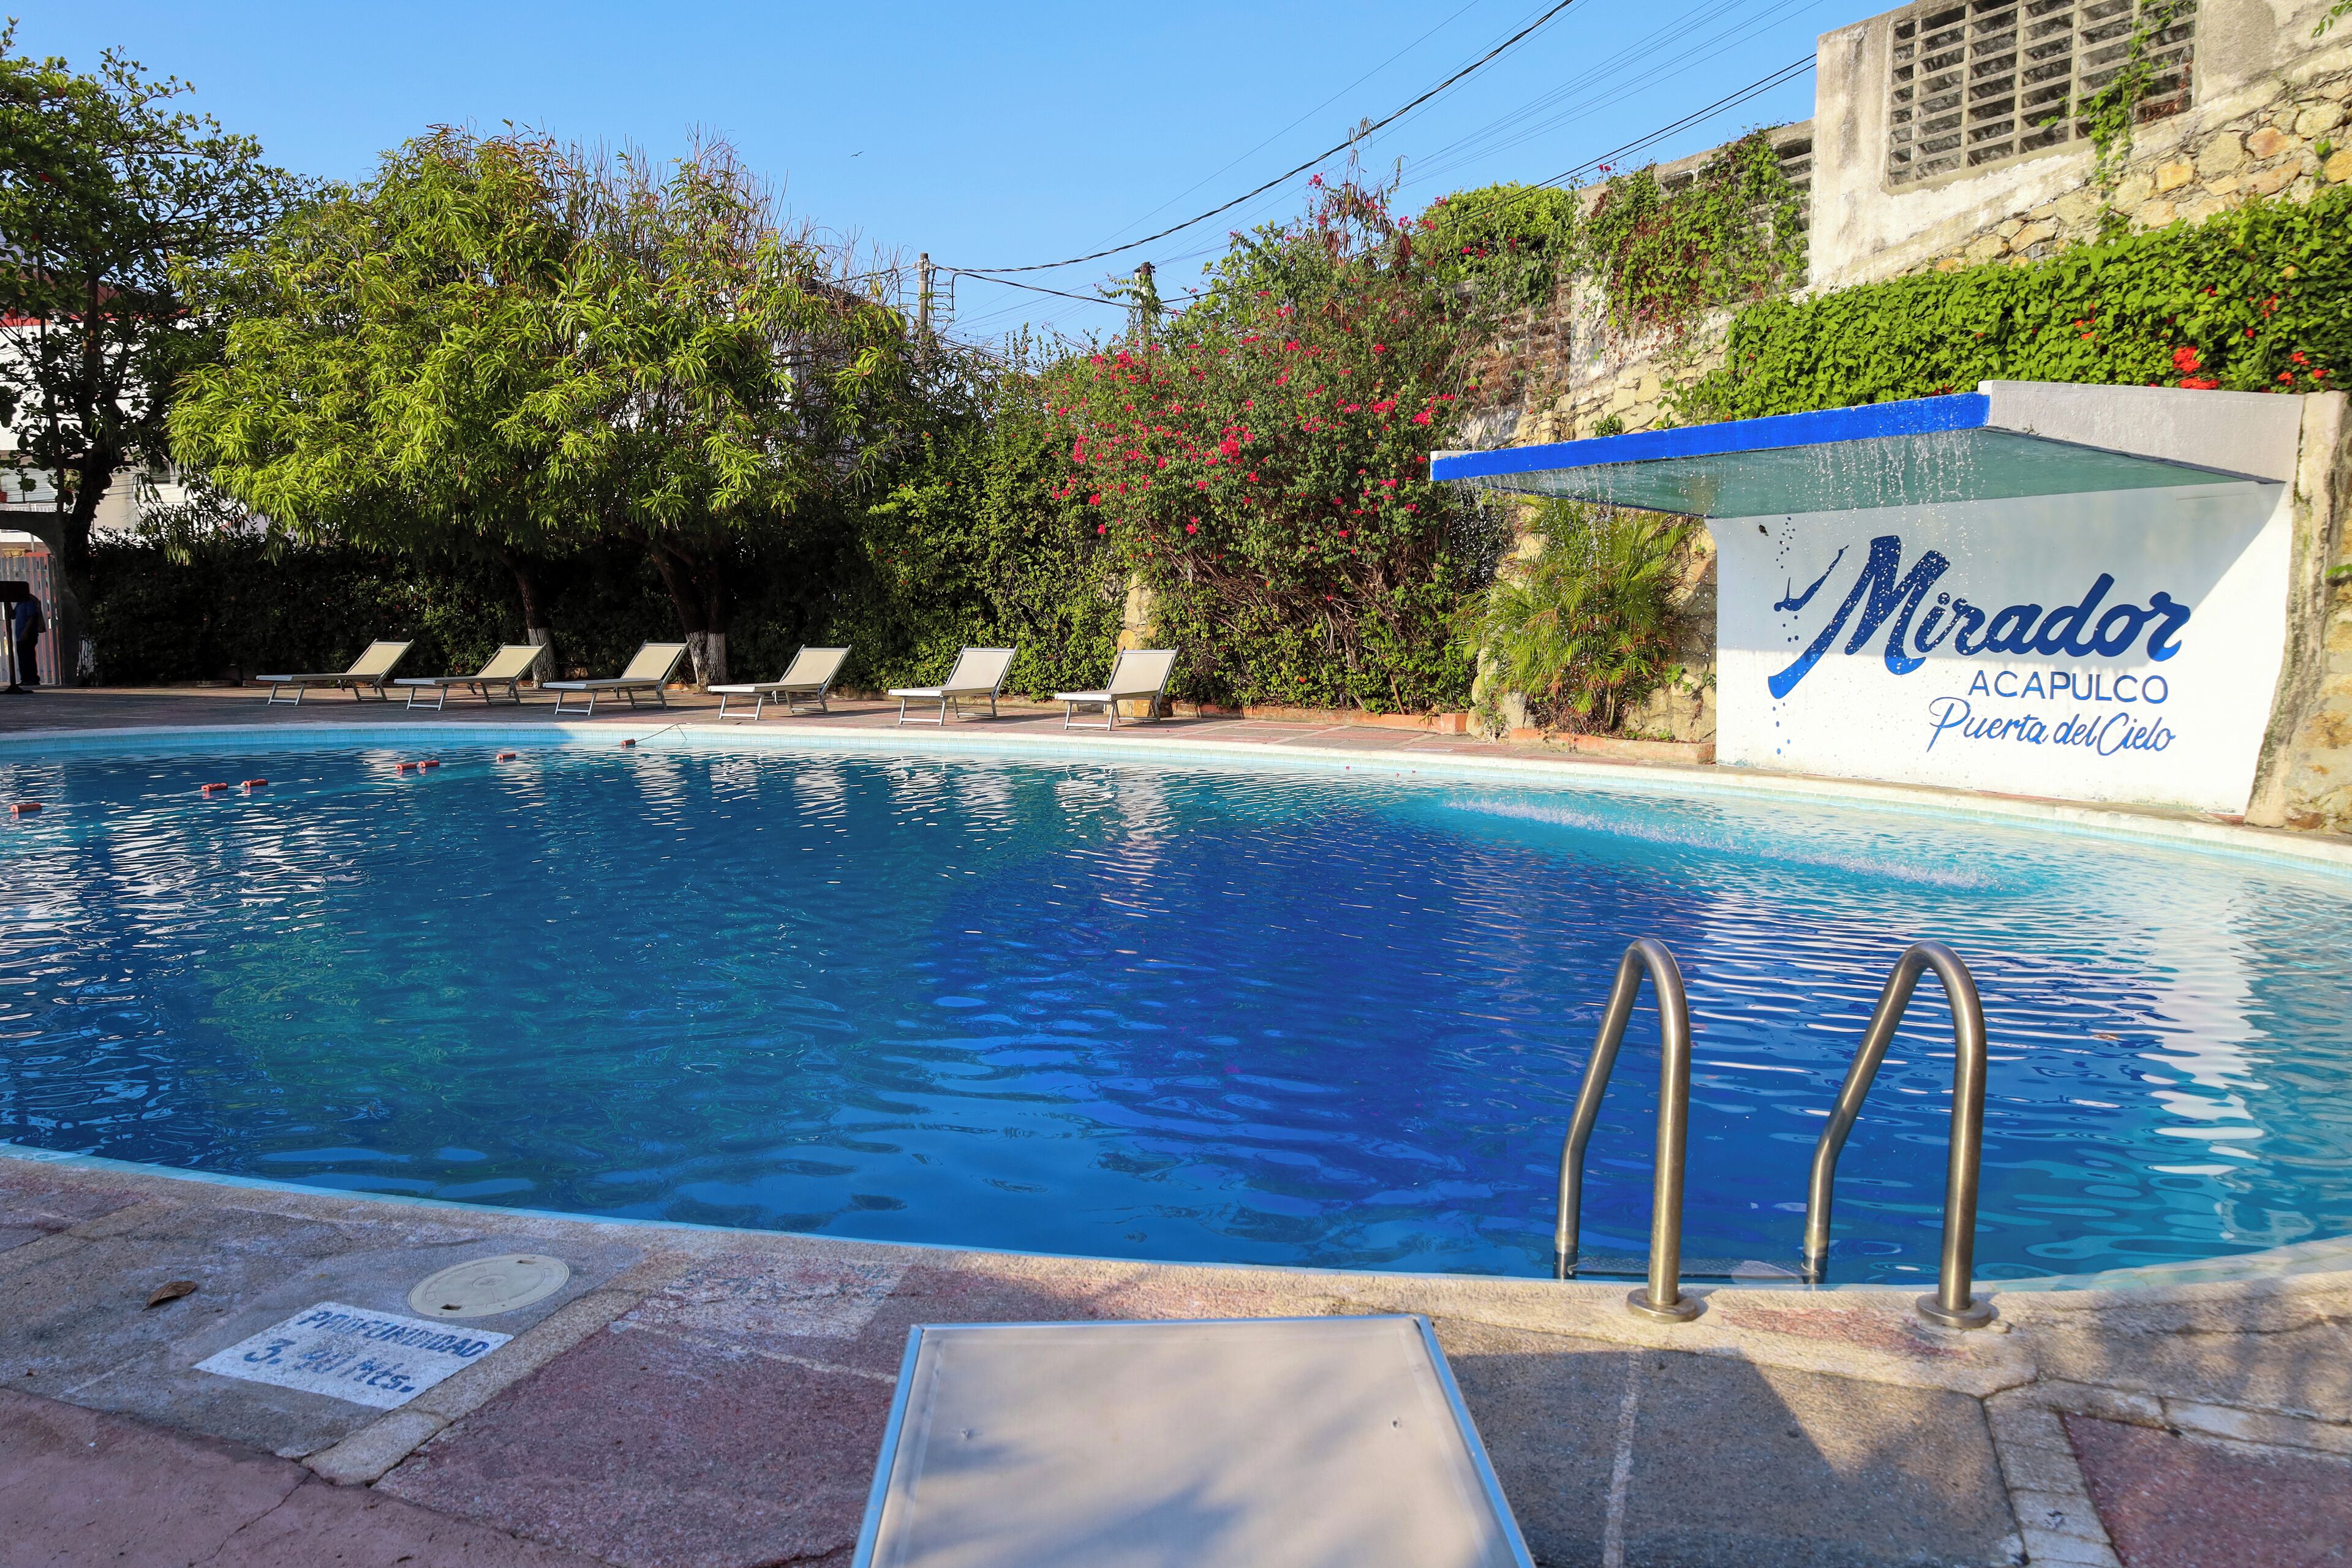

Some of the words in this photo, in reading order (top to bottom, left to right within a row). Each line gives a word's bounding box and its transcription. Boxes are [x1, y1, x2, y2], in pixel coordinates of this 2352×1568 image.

[1768, 535, 2191, 699] Mirador
[1968, 671, 2169, 704] ACAPULCO
[1927, 696, 2048, 753] Puerta
[2052, 714, 2101, 747] del
[2097, 712, 2176, 756] Cielo
[297, 1311, 489, 1357] PROFUNDIDAD
